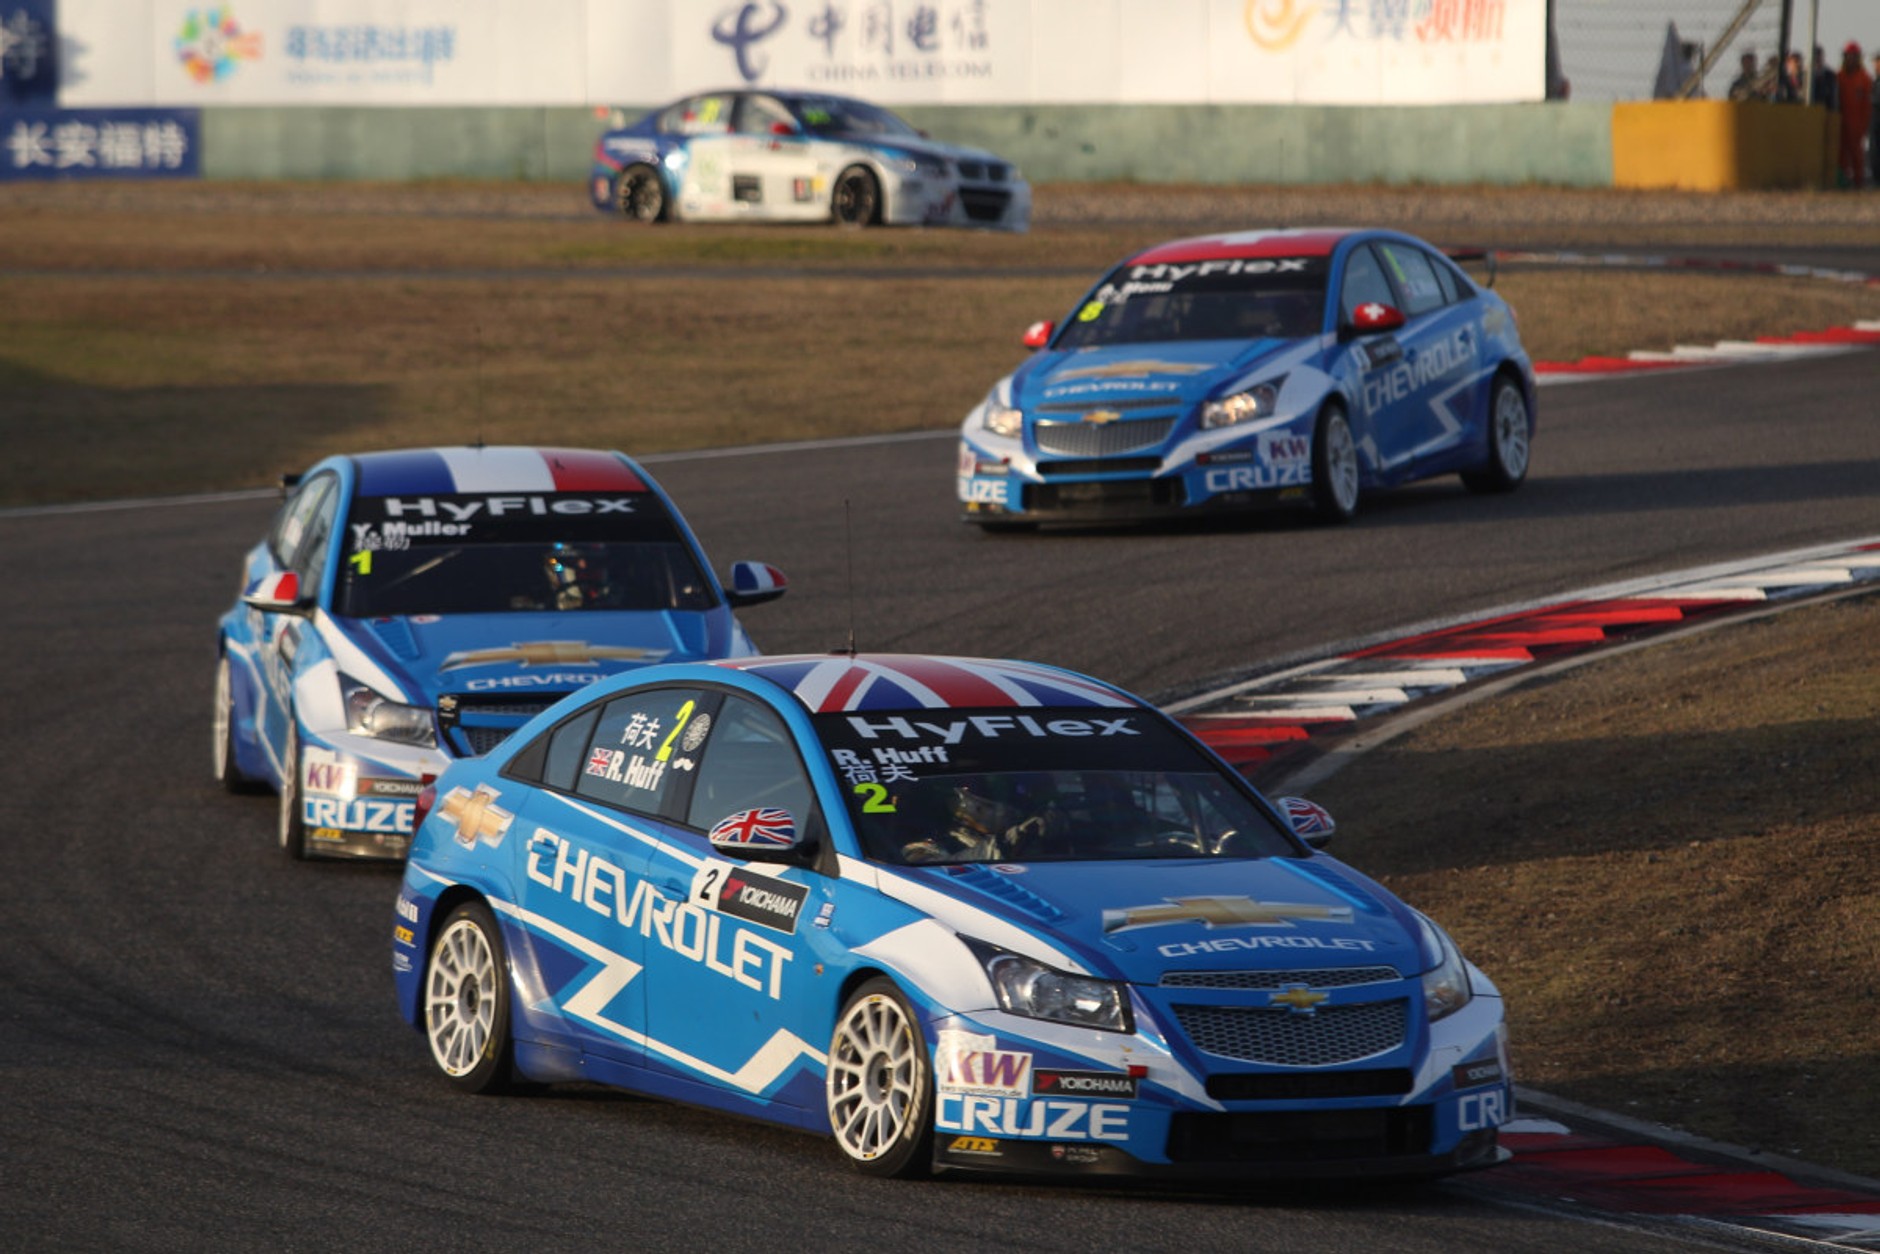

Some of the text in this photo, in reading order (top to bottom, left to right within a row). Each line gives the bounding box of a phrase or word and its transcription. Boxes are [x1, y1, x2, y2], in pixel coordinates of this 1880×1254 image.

[6, 119, 188, 168] 长安福特
[1130, 259, 1308, 281] HyFlex
[1364, 322, 1477, 416] CHEVROLET
[1043, 382, 1181, 398] CHEVROLET
[1206, 464, 1314, 492] CRUZE
[384, 497, 635, 521] HyFlex
[382, 521, 473, 537] Muller
[350, 550, 372, 575] 1
[467, 673, 608, 690] CHEVRO
[620, 712, 661, 750] 荷夫
[656, 700, 695, 761] 2
[847, 715, 1142, 744] HyFlex
[832, 746, 949, 765] R. Huff
[605, 750, 667, 792] R. Huff
[840, 763, 919, 785] 荷夫
[853, 783, 897, 813] 2
[303, 796, 417, 832] CRUZE
[700, 869, 719, 900] 2
[739, 885, 798, 918] YOKOHAMA
[527, 827, 794, 1000] CHEVROLET
[1157, 936, 1377, 957] CHEVROLET
[946, 1050, 1029, 1089] KW
[1058, 1076, 1134, 1093] YOKOHAMA
[935, 1092, 1130, 1140] CRUZE
[949, 1136, 1000, 1152] ATS
